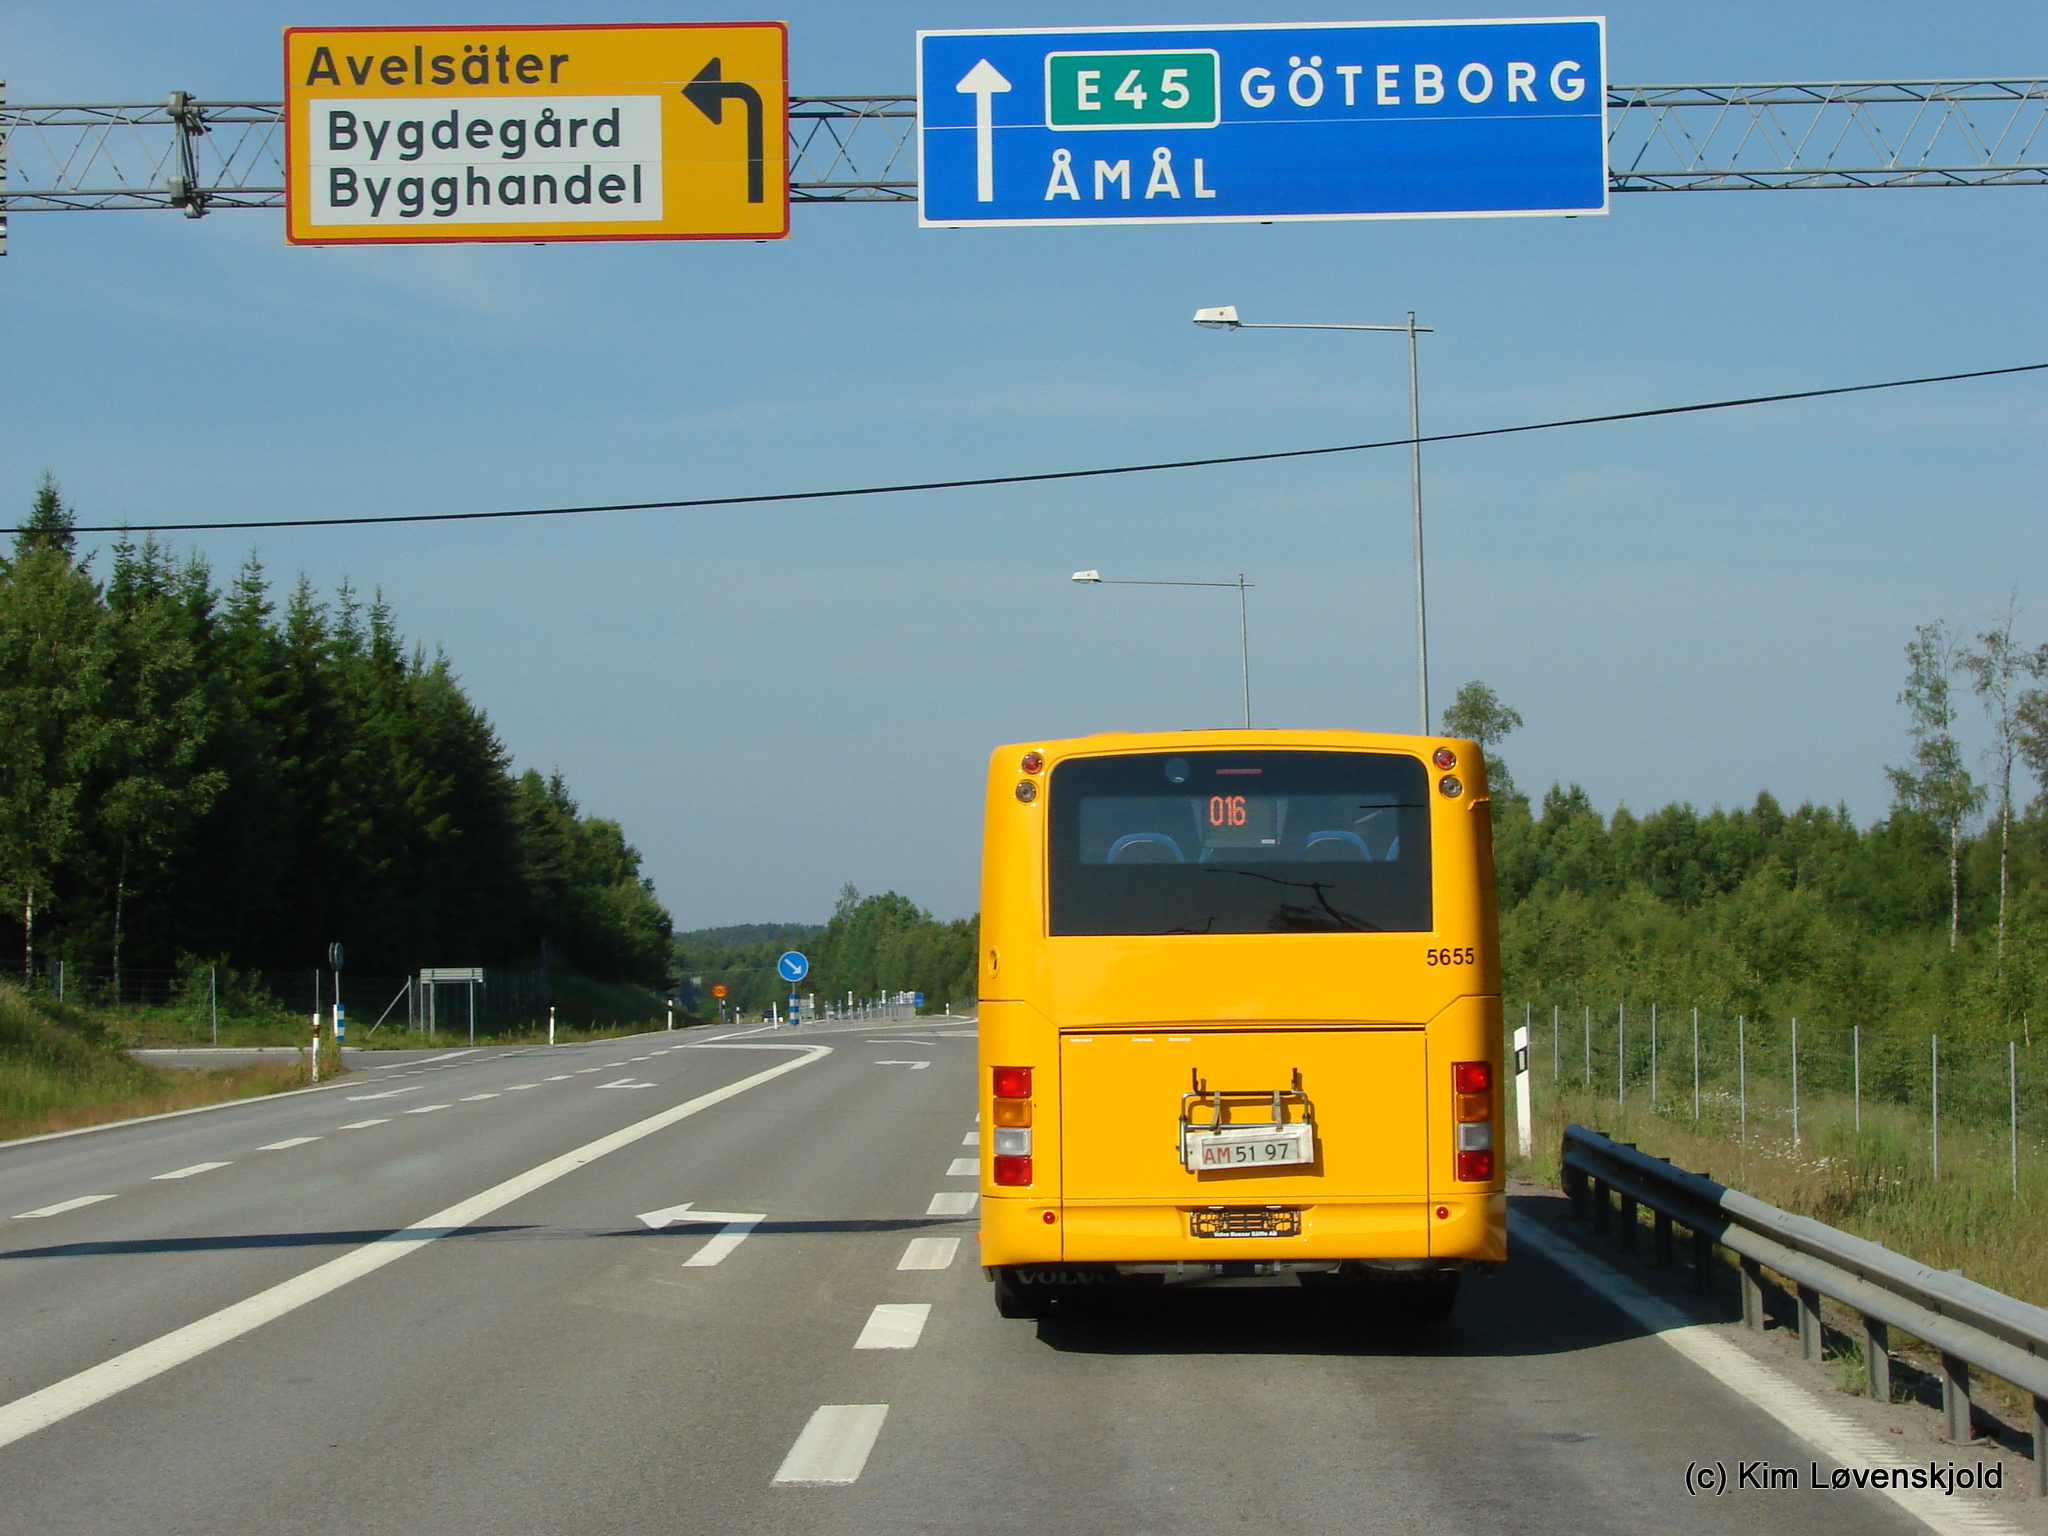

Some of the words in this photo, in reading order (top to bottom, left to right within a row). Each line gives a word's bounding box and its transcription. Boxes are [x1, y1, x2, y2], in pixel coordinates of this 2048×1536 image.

[306, 44, 569, 86] Avelsäter
[1240, 55, 1586, 109] GÖTEBORG
[328, 107, 621, 160] Bygdegård
[329, 164, 642, 218] Bygghandel
[1045, 146, 1216, 201] ÅMÅL
[1209, 796, 1246, 826] 016
[1427, 947, 1475, 967] 5655
[1204, 1147, 1231, 1164] AM
[1236, 1145, 1255, 1163] 51
[1265, 1143, 1289, 1160] 97
[1014, 1269, 1113, 1285] VOLVO
